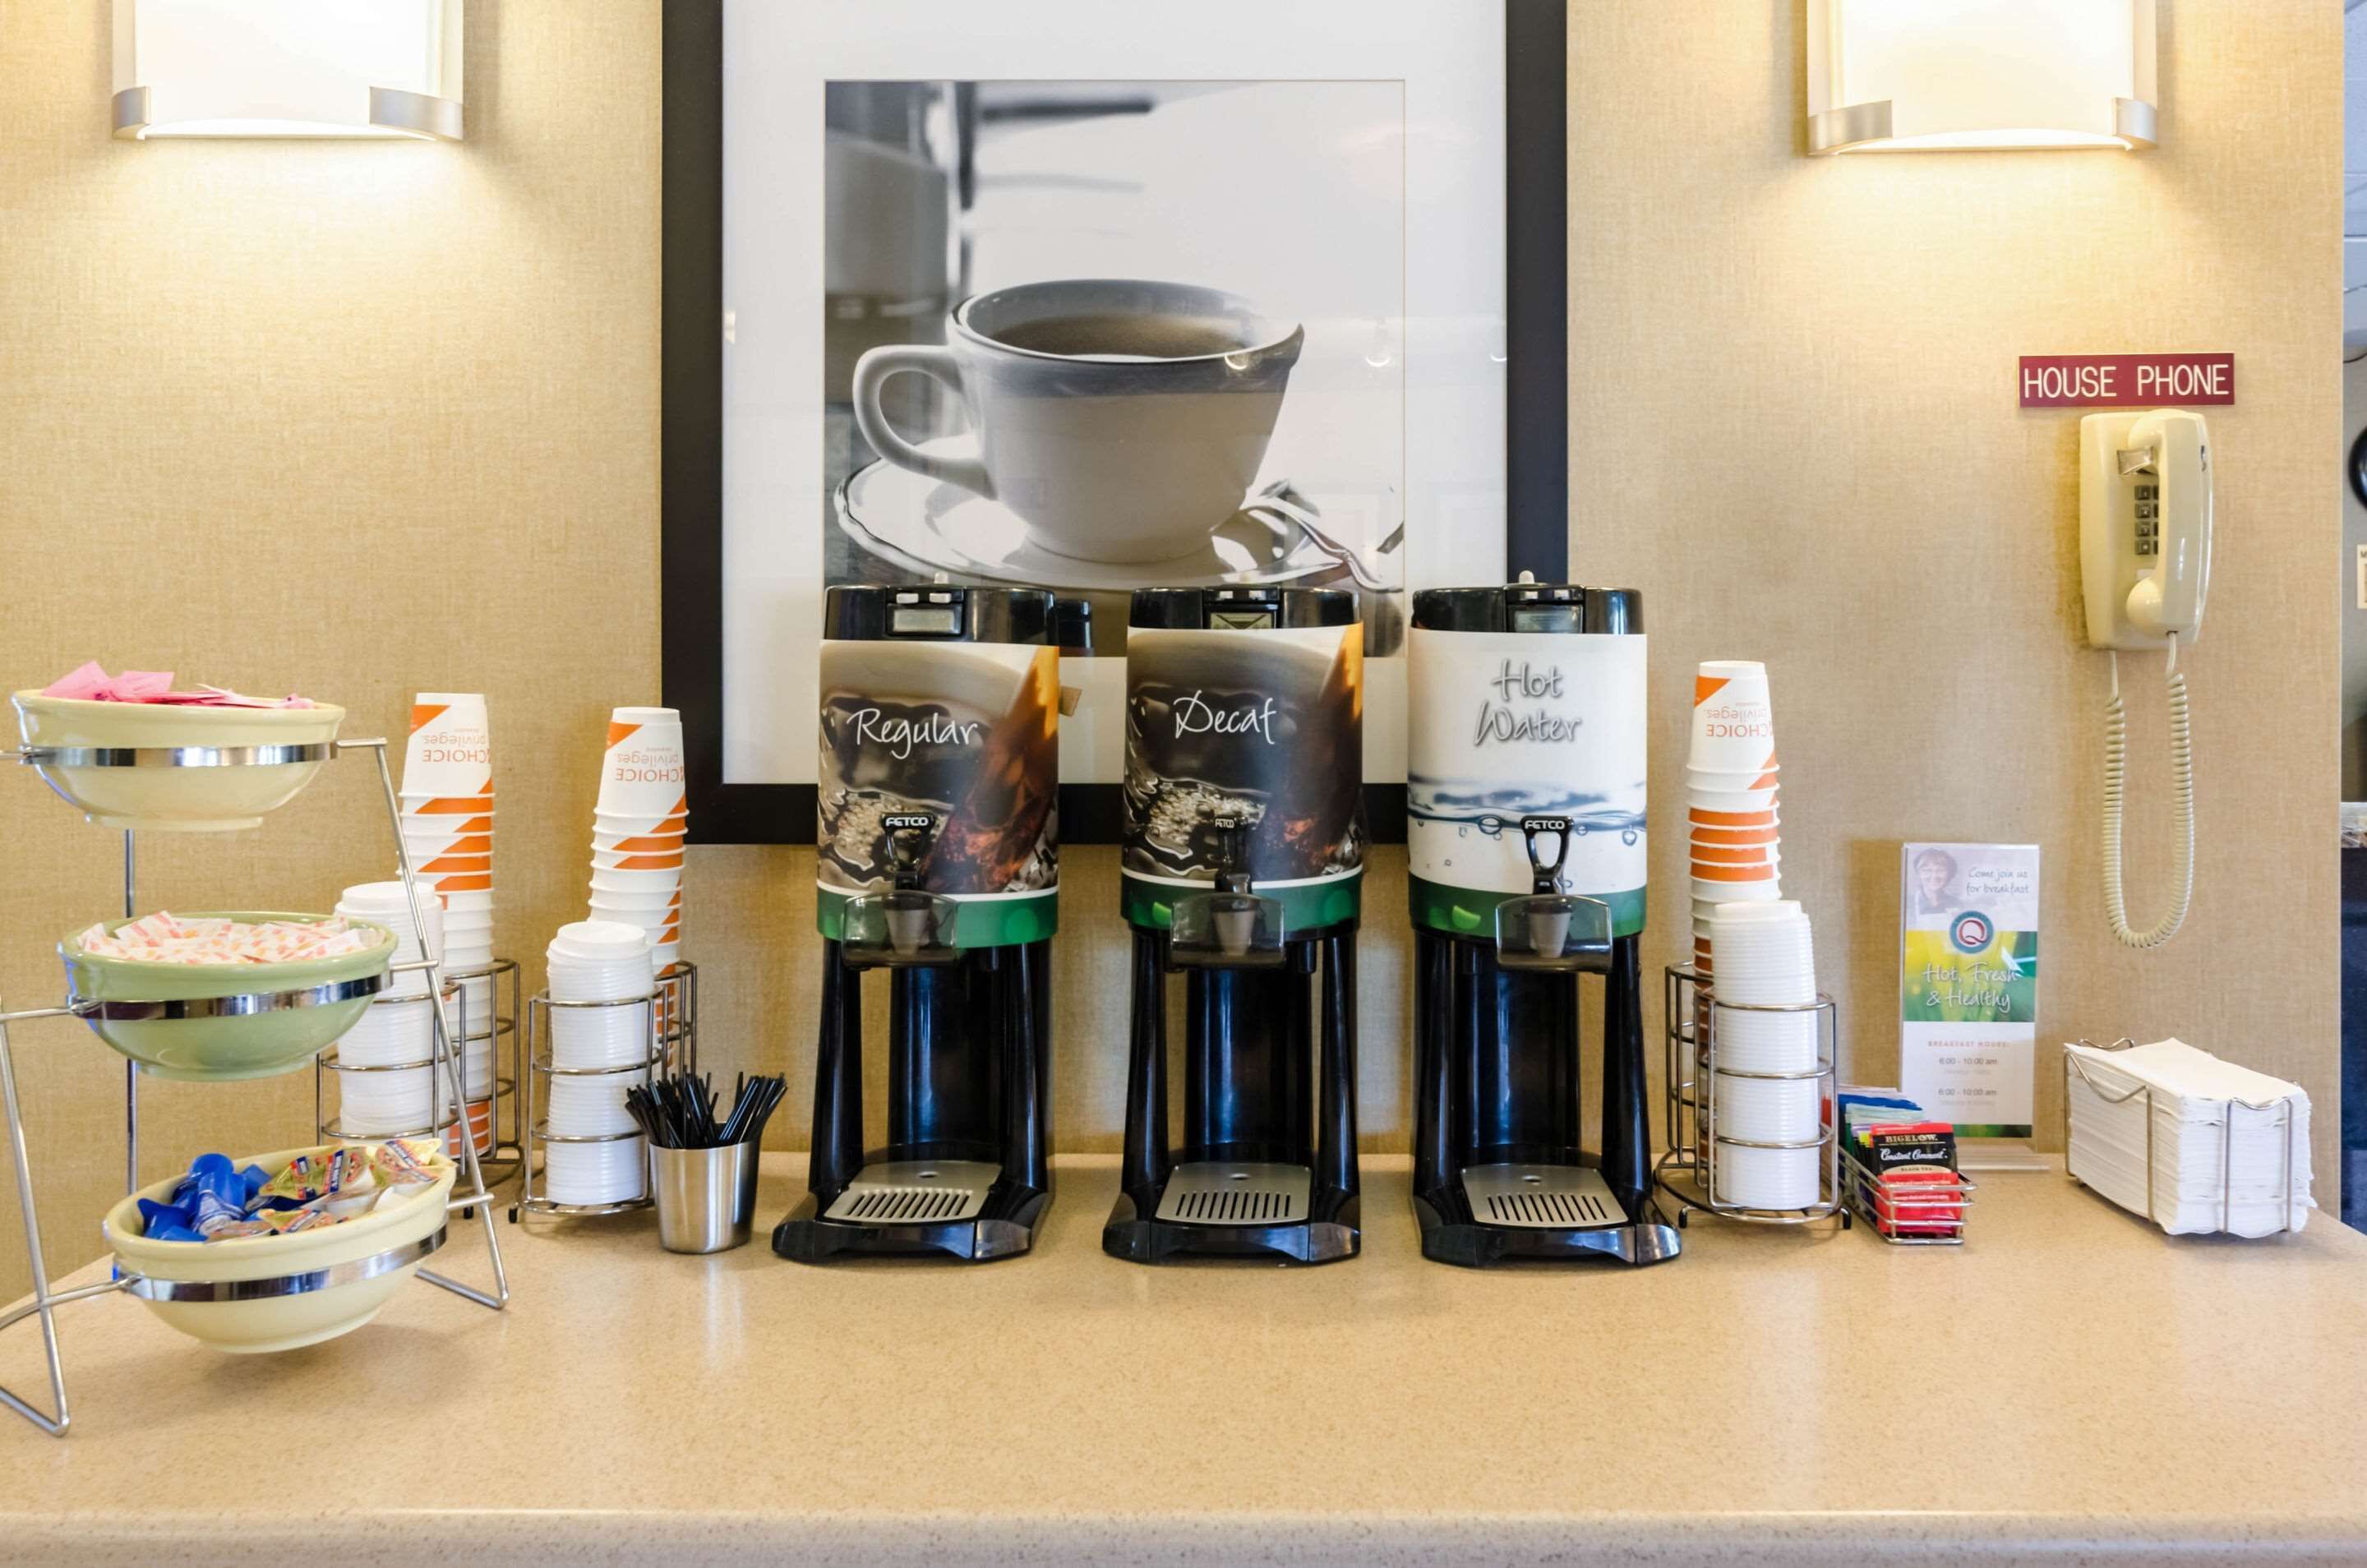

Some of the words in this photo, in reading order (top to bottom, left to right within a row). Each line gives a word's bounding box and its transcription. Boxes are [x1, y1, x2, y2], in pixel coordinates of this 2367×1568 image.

[2024, 366, 2117, 398] HOUSE
[2138, 364, 2229, 396] PHONE
[1492, 658, 1563, 700] Hot
[1173, 689, 1277, 745] Decaf
[1473, 701, 1582, 746] Water
[847, 708, 978, 759] Regular
[1706, 723, 1768, 737] CHOICE
[422, 749, 487, 763] CHOICE
[616, 768, 679, 782] CHOICE
[885, 817, 929, 827] FETCO
[1525, 820, 1565, 829] FETCO
[1968, 866, 1995, 879] Come
[1995, 868, 2014, 882] join
[1966, 883, 1981, 895] for
[1984, 883, 2029, 895] breakfast
[1959, 920, 1989, 945] Q
[1922, 962, 1962, 983] Hot,
[1966, 961, 2019, 981] Fresh
[1926, 991, 1940, 1007] &
[1946, 989, 2011, 1012] Healthy
